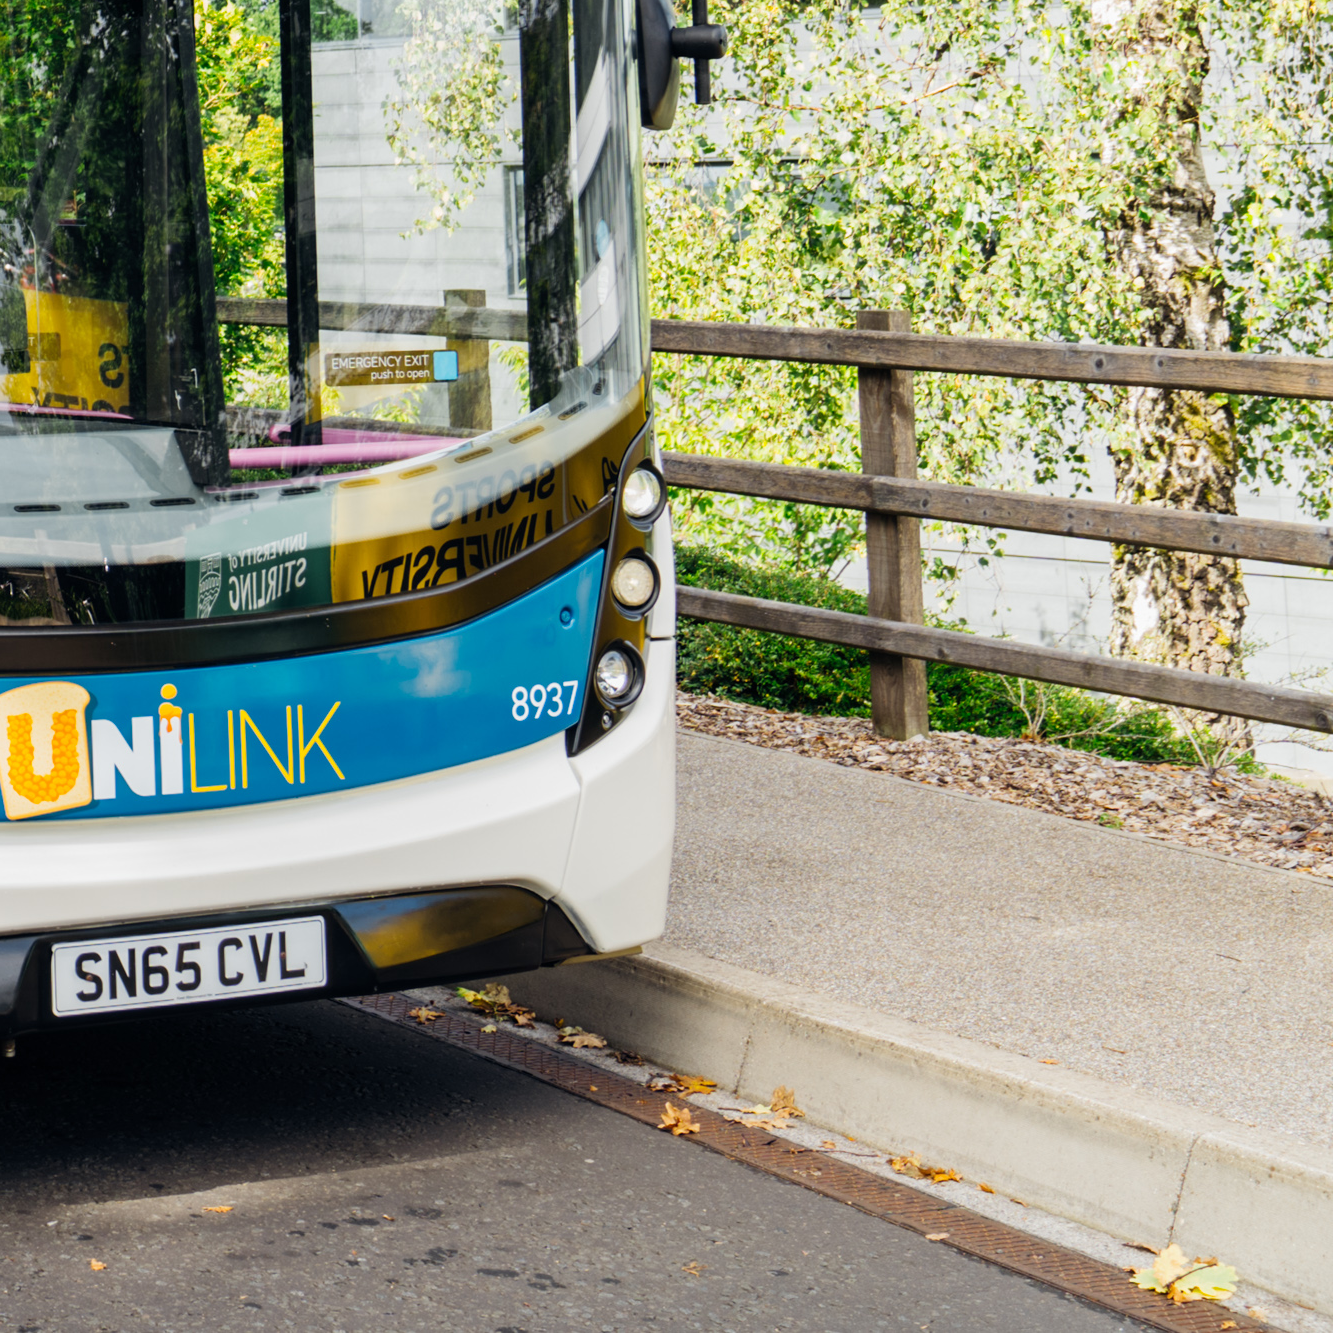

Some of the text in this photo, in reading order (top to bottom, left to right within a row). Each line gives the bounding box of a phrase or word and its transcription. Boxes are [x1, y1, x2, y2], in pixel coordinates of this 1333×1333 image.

[331, 354, 430, 370] EMERGENCY EXIT
[370, 369, 431, 381] push to open
[511, 679, 579, 722] 8937
[73, 930, 307, 1002] SN65 CVL
